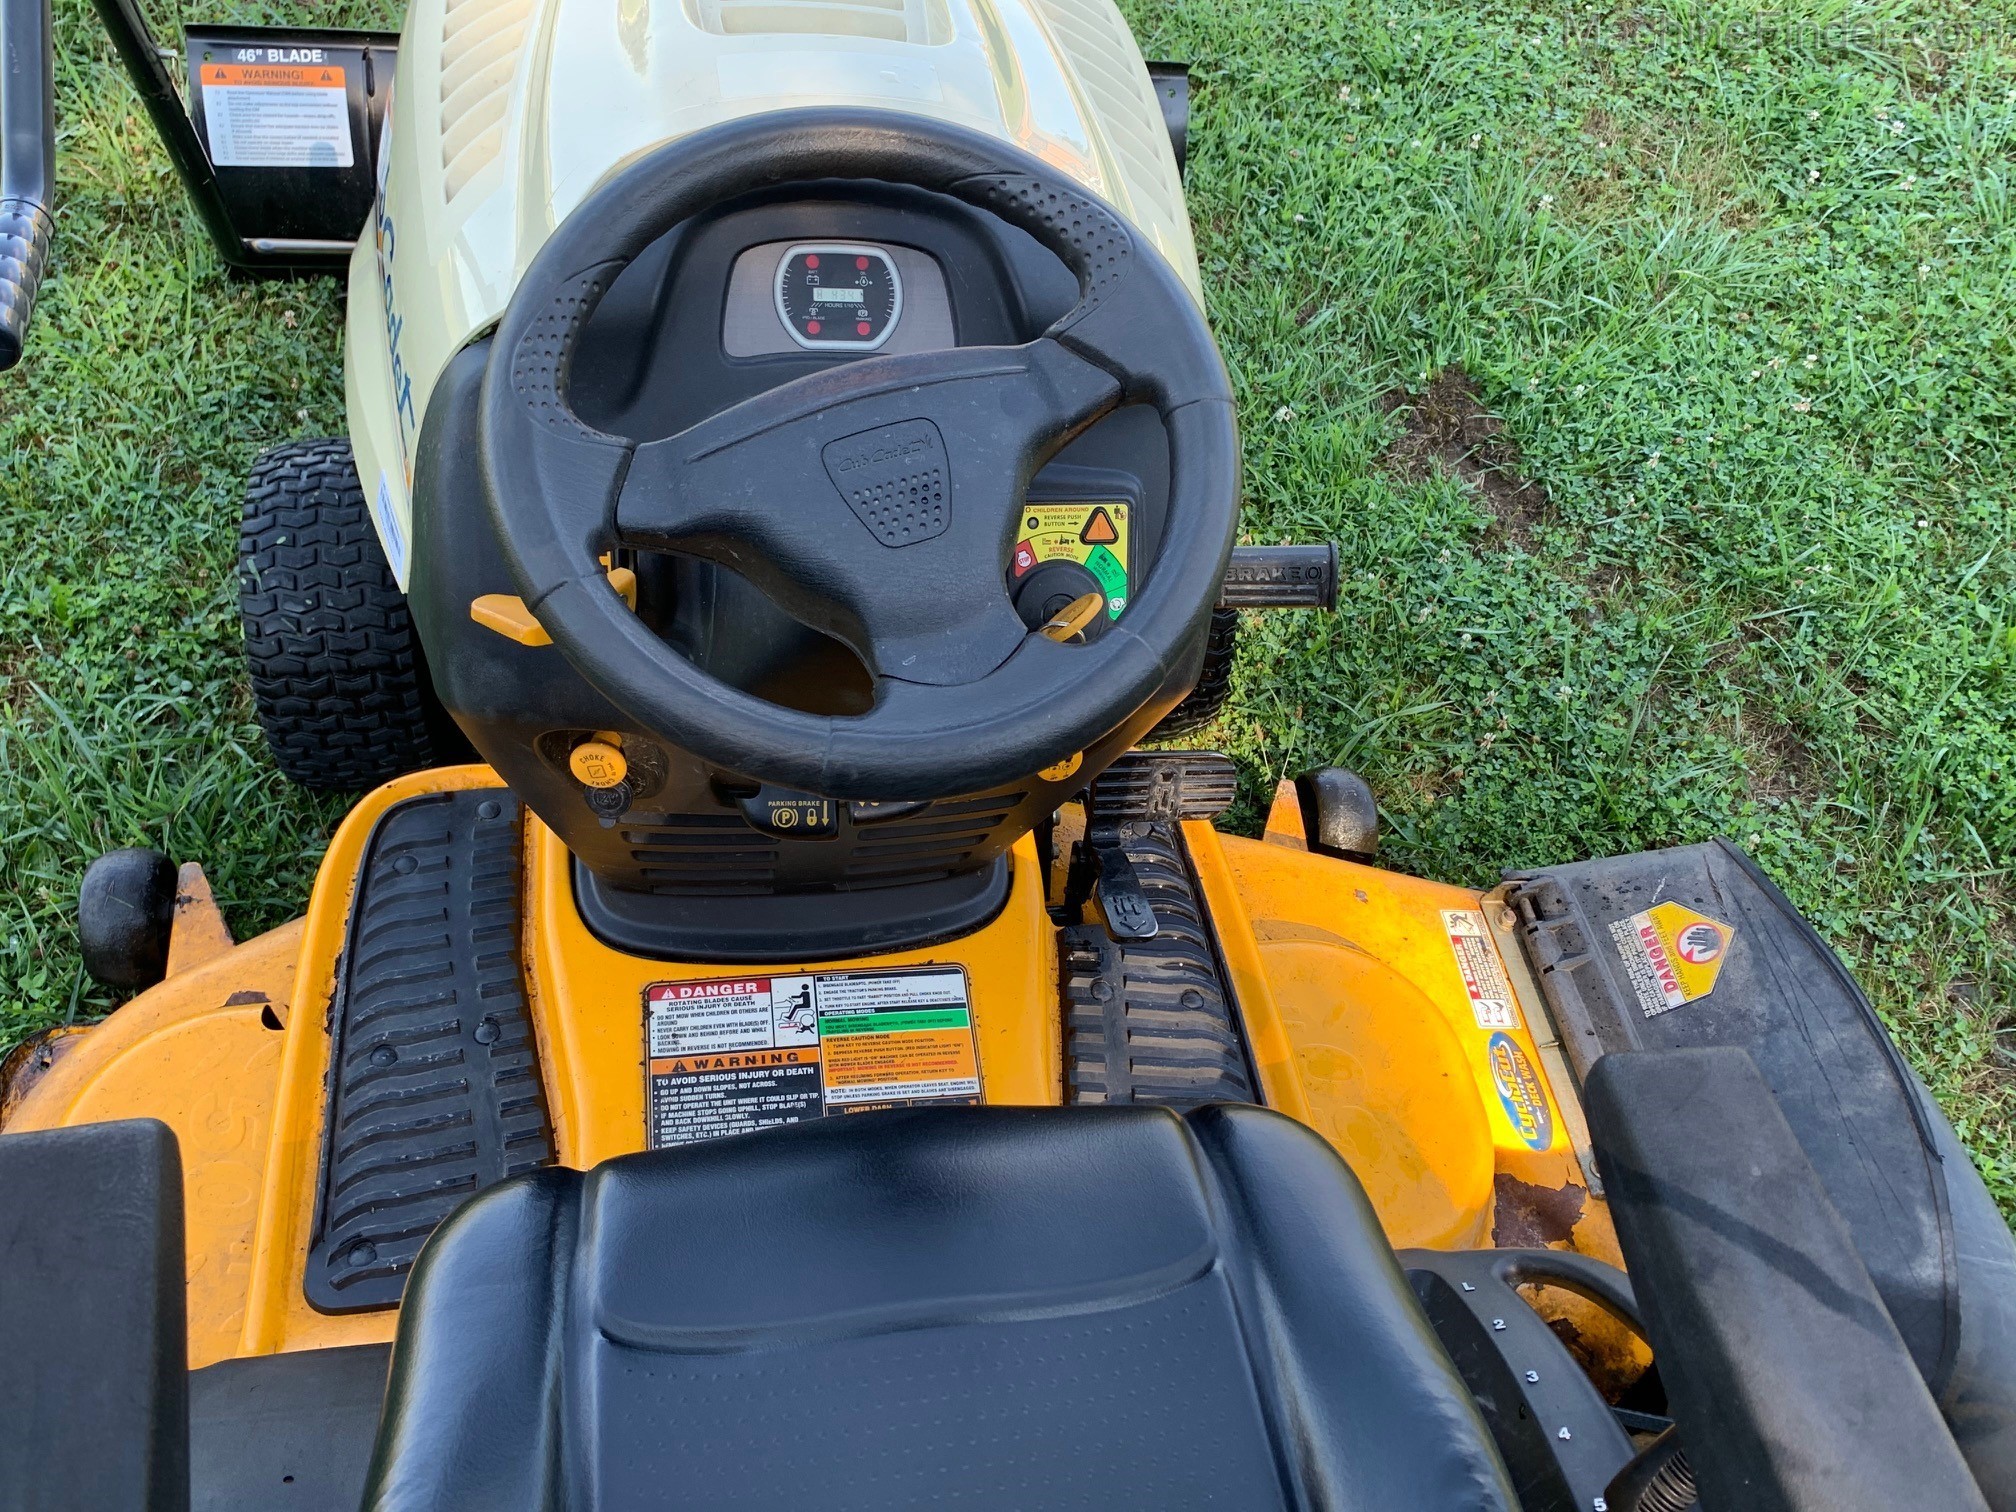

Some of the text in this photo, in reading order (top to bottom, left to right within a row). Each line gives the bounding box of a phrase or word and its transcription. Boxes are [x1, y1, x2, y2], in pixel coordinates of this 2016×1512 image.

[237, 48, 323, 63] 46" BLADE
[241, 69, 304, 80] WARNING!
[1018, 556, 1030, 565] STOP
[1095, 560, 1112, 582] NORMAL
[1224, 566, 1301, 581] BRAKE
[579, 754, 605, 764] CHOKE
[1639, 925, 1678, 993] DANGER
[1650, 911, 1692, 996] KEEP HANDS and FEET AWAY
[1453, 943, 1472, 983] DANGER
[680, 983, 757, 998] DANGER
[666, 1004, 695, 1012] SERIOUS
[696, 1002, 720, 1010] INJURY
[733, 999, 755, 1007] DEATH
[668, 998, 702, 1007] ROTATING
[704, 996, 729, 1004] BLADES
[705, 1009, 729, 1017] CHILDREN
[689, 1023, 712, 1031] CHILDREN
[738, 1019, 759, 1027] BLADE(S)
[719, 1028, 738, 1036] BEFORE
[657, 1046, 679, 1054] MOWING
[694, 1052, 799, 1070] WARNING
[1513, 1050, 1535, 1079] WASH
[656, 1066, 814, 1086] TO AVOID SERIOUS INJURY OR DEATH
[693, 1085, 711, 1093] DOWN
[712, 1083, 737, 1091] SLOPES,
[751, 1079, 777, 1088] ACROSS.
[1492, 1045, 1538, 1140] CycloCut
[660, 1091, 726, 1103] AVOID SUDDEN TURNS.
[1515, 1078, 1532, 1111] SYSTEM
[1526, 1081, 1544, 1107] DECK
[682, 1101, 709, 1109] OPERATE
[765, 1094, 785, 1102] COULD
[667, 1110, 695, 1118] MACHINE
[717, 1106, 736, 1114] GOING
[737, 1104, 761, 1112] UPHILL,
[844, 1106, 870, 1115] LOWER
[660, 1126, 677, 1134] KEEP
[677, 1124, 701, 1132] SAFETY
[702, 1122, 728, 1130] DEVICES
[758, 1117, 785, 1125] SHIELDS,
[674, 1117, 691, 1125] BACK
[692, 1115, 723, 1123] DOWNHILL
[661, 1132, 694, 1141] SWITCHES,
[720, 1128, 739, 1136] PLACE
[1493, 1318, 1506, 1330] 2
[1526, 1370, 1539, 1382] 3
[1558, 1426, 1571, 1440] 4
[1593, 1498, 1607, 1512] 5
